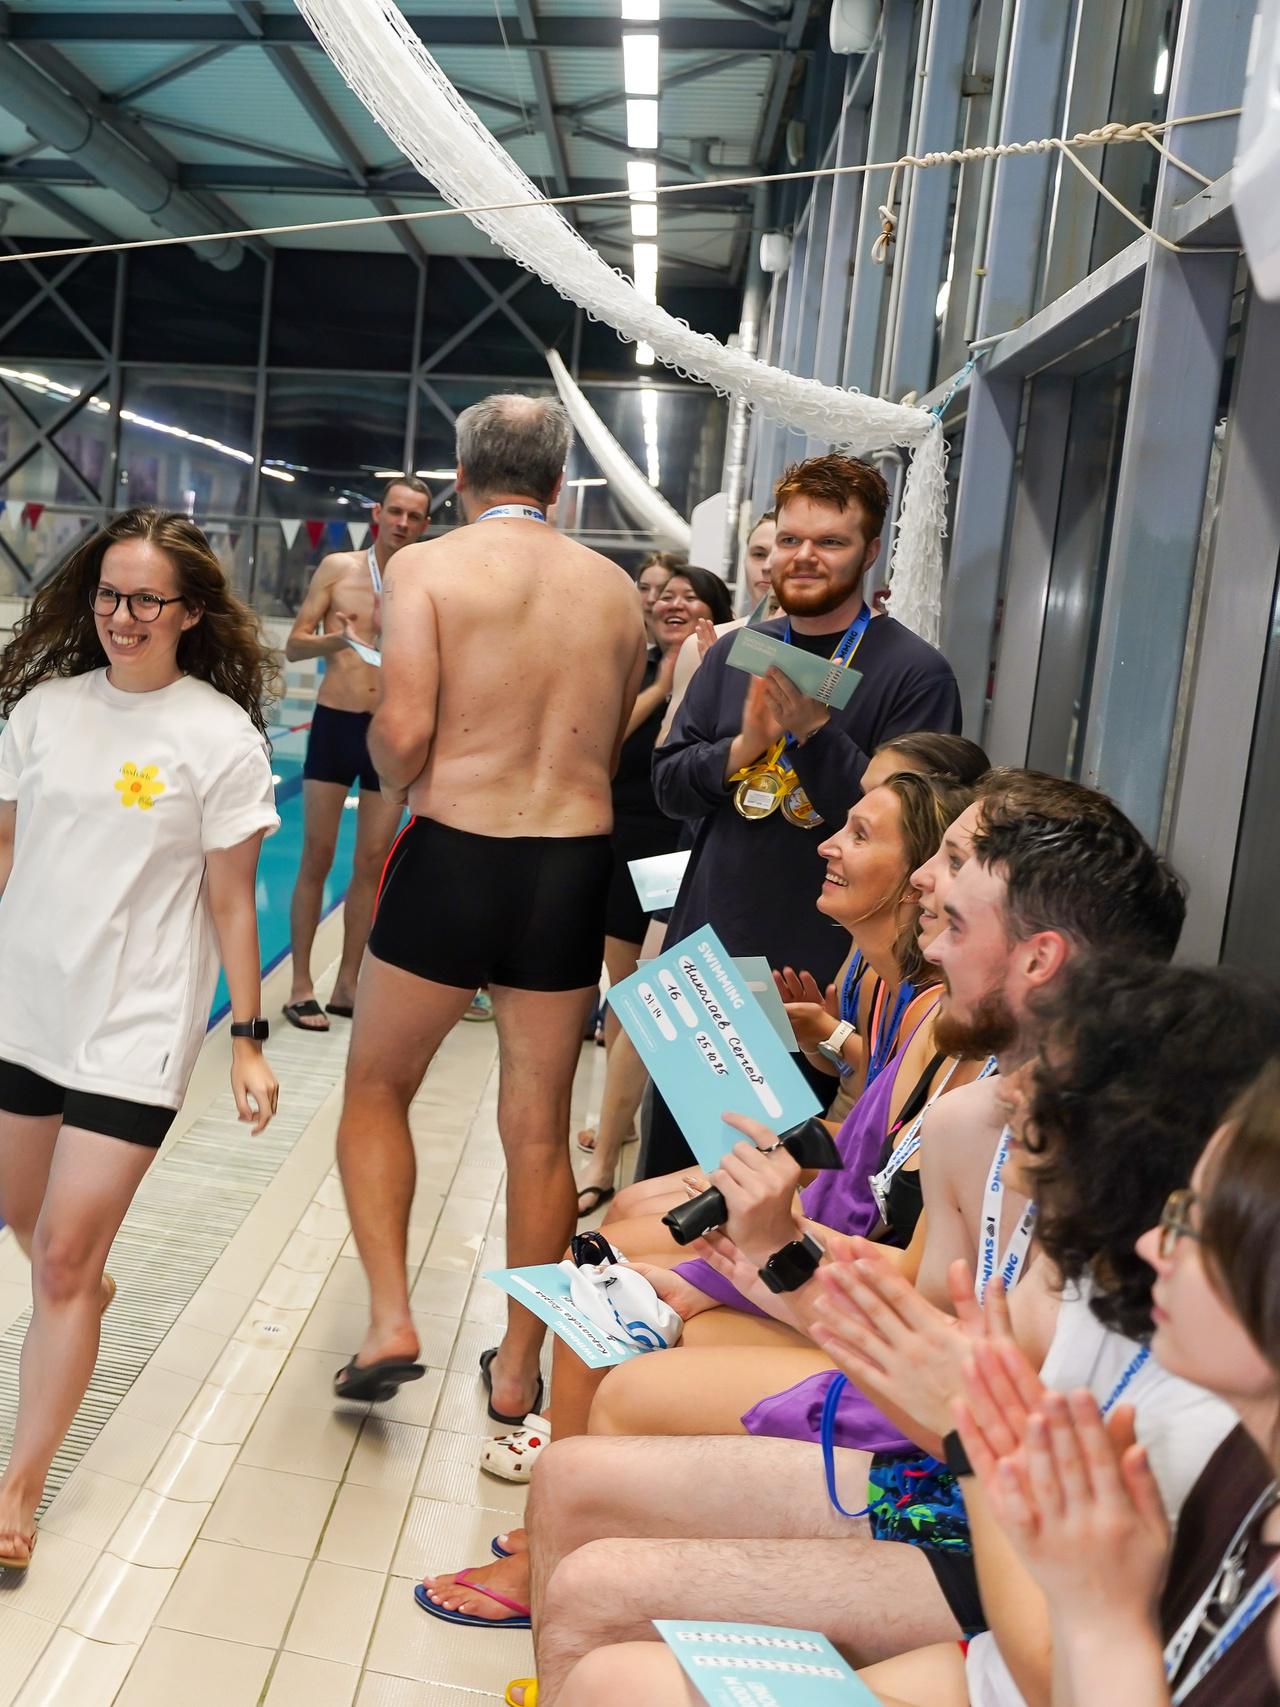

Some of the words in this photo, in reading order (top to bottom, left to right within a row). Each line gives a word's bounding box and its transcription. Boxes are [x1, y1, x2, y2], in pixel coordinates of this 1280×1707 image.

[838, 630, 858, 661] MMING
[667, 984, 682, 1001] 16
[697, 941, 745, 1010] SWIMMING
[683, 960, 731, 1030] Николаев
[728, 1037, 764, 1085] Сергей
[554, 1320, 598, 1361] SWIMMING
